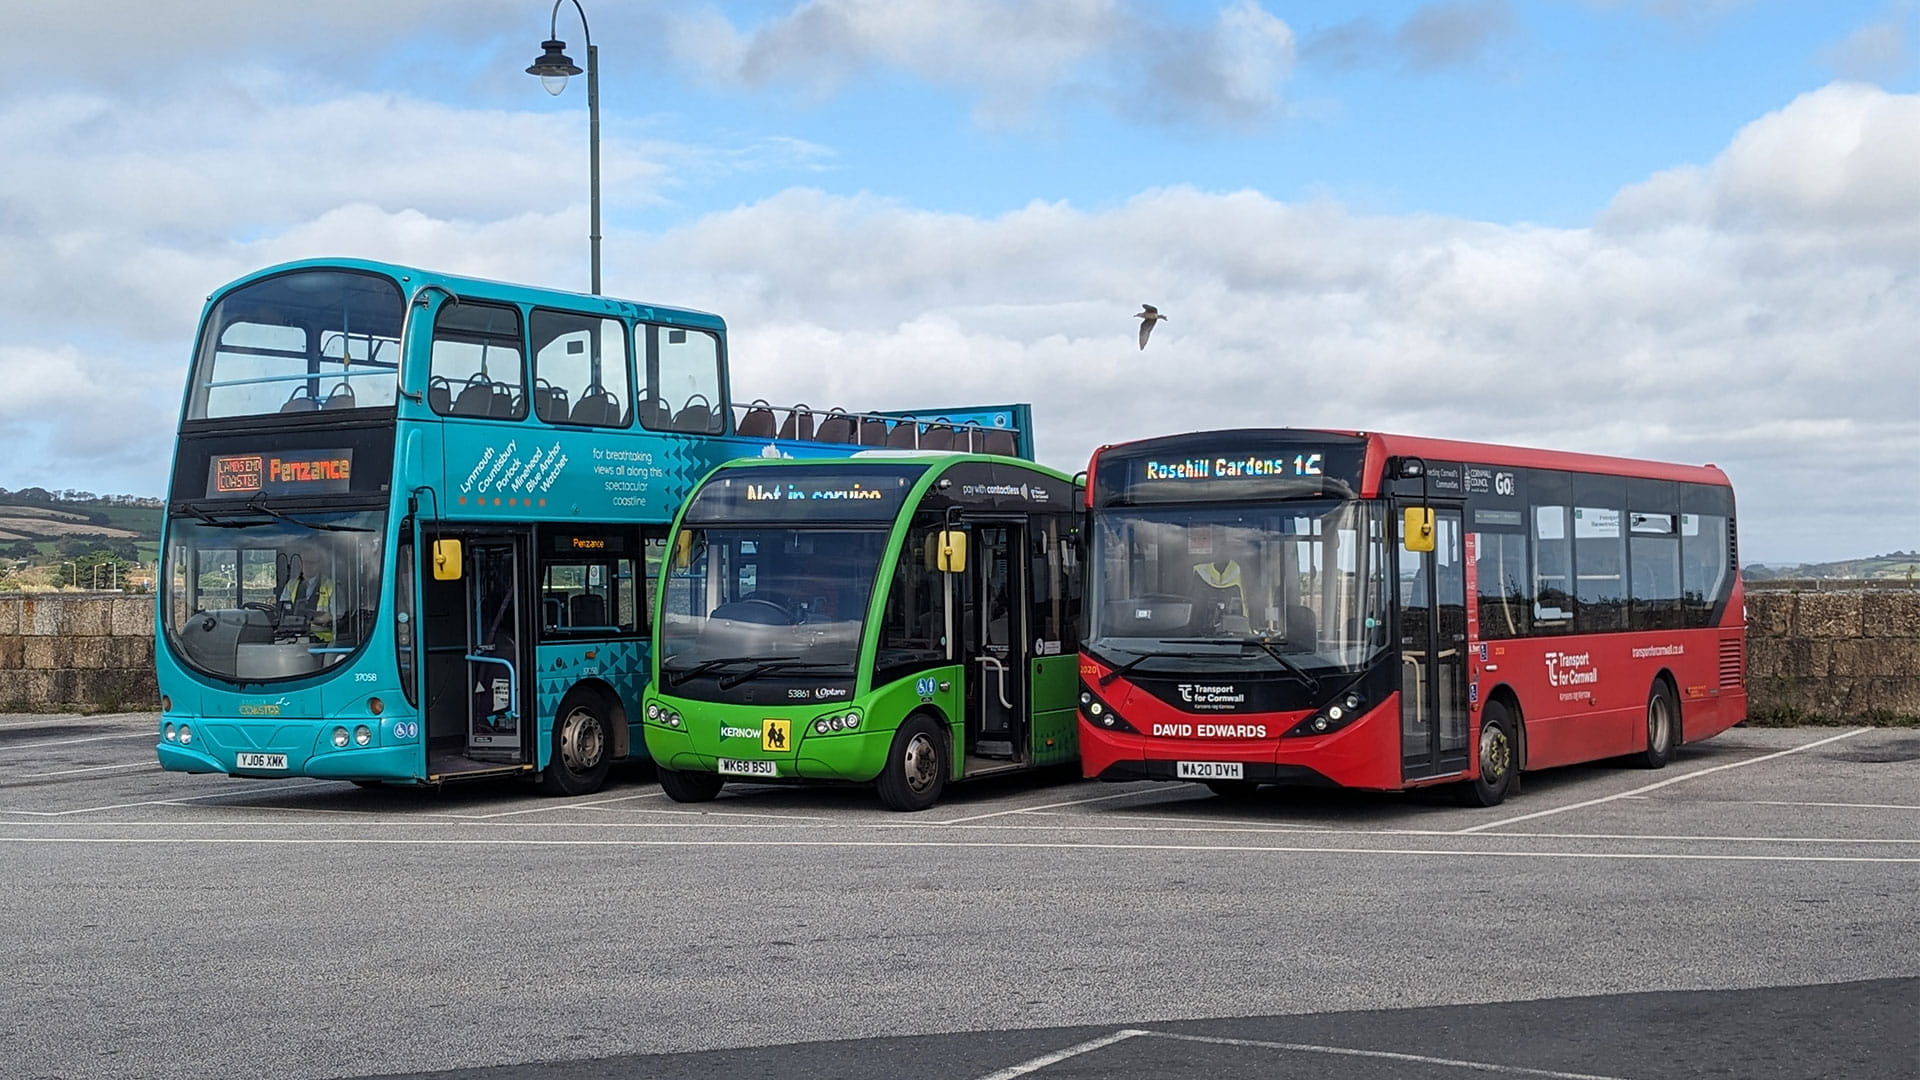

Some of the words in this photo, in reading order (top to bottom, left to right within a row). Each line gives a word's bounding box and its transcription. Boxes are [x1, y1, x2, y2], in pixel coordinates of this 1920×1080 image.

[592, 448, 604, 460] for
[606, 448, 653, 465] breathtaking
[270, 458, 351, 483] Penzance
[459, 446, 496, 494] Lynmouth
[477, 439, 519, 494] Countisbury
[510, 447, 544, 494] Minehead
[525, 468, 543, 494] Blue
[537, 441, 563, 475] Anchor
[539, 453, 570, 494] Watchet
[593, 465, 614, 476] views
[616, 464, 625, 476] all
[627, 465, 649, 479] along
[650, 465, 664, 478] this
[1147, 459, 1209, 479] Rosehill
[1215, 457, 1283, 477] Gardens
[495, 457, 523, 493] Porlock
[604, 480, 648, 493] spectacular
[986, 484, 1020, 496] contactless
[1495, 472, 1511, 495] Go
[612, 496, 647, 507] coastline
[572, 537, 605, 549] Penzance
[1558, 651, 1590, 669] Transport
[1080, 665, 1097, 674] 2020
[1558, 670, 1568, 686] for
[1568, 667, 1598, 685] Cornwall
[354, 672, 377, 683] 37058
[787, 688, 810, 698] 53861
[820, 687, 847, 698] Optare
[1193, 684, 1234, 695] Transport
[1193, 693, 1206, 703] for
[1207, 693, 1245, 703] Cornwall
[720, 726, 762, 739] KERNOW
[1153, 723, 1193, 738] DAVID
[1197, 724, 1267, 738] EDWARDS
[241, 754, 265, 767] YJ06
[266, 754, 285, 768] XMK
[723, 759, 750, 773] WK68
[752, 760, 773, 774] BSU
[1182, 763, 1213, 777] WA20
[1215, 764, 1240, 777] DVH
